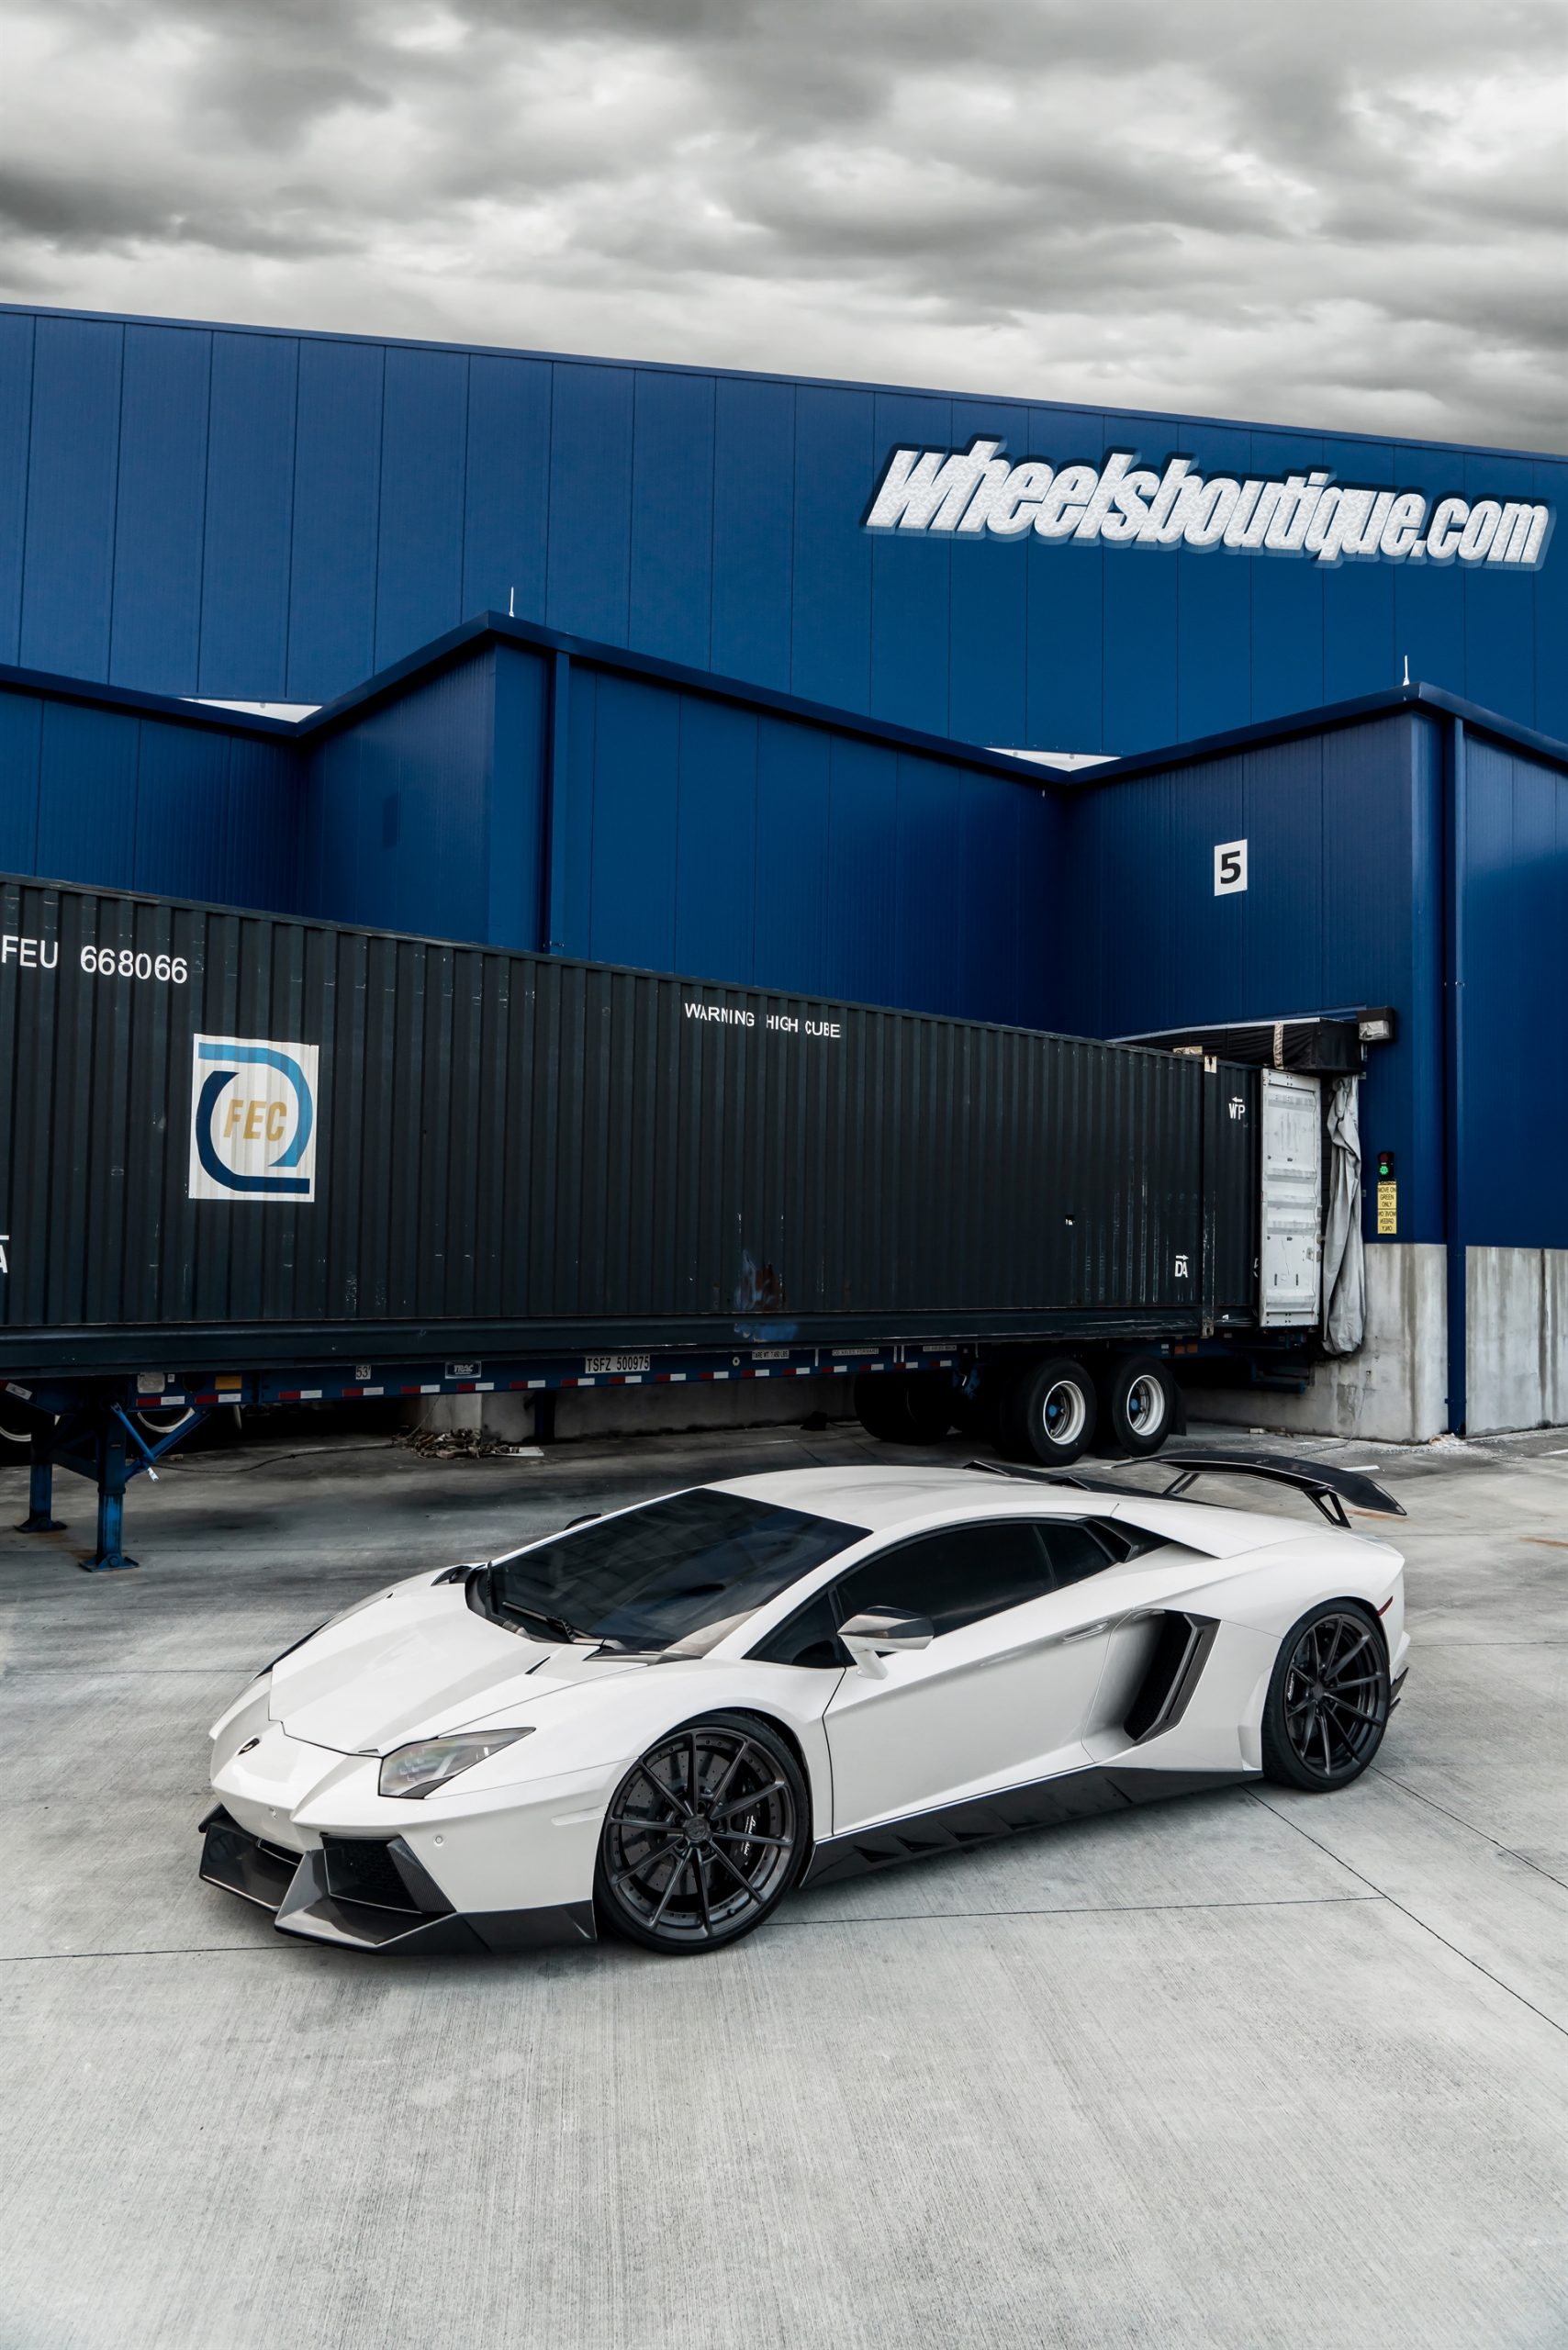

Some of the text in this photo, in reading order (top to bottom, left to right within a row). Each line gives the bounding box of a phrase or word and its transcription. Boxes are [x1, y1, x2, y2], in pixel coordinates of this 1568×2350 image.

[1220, 850, 1241, 884] 5
[1, 934, 188, 984] FEU 668066
[684, 1002, 841, 1038] WARNING HIGH CUBE
[223, 1099, 287, 1142] FEC
[1228, 1102, 1246, 1121] WP
[1175, 1260, 1189, 1278] DA
[454, 1364, 474, 1372] TRAC
[587, 1356, 649, 1371] TSFZ 500975
